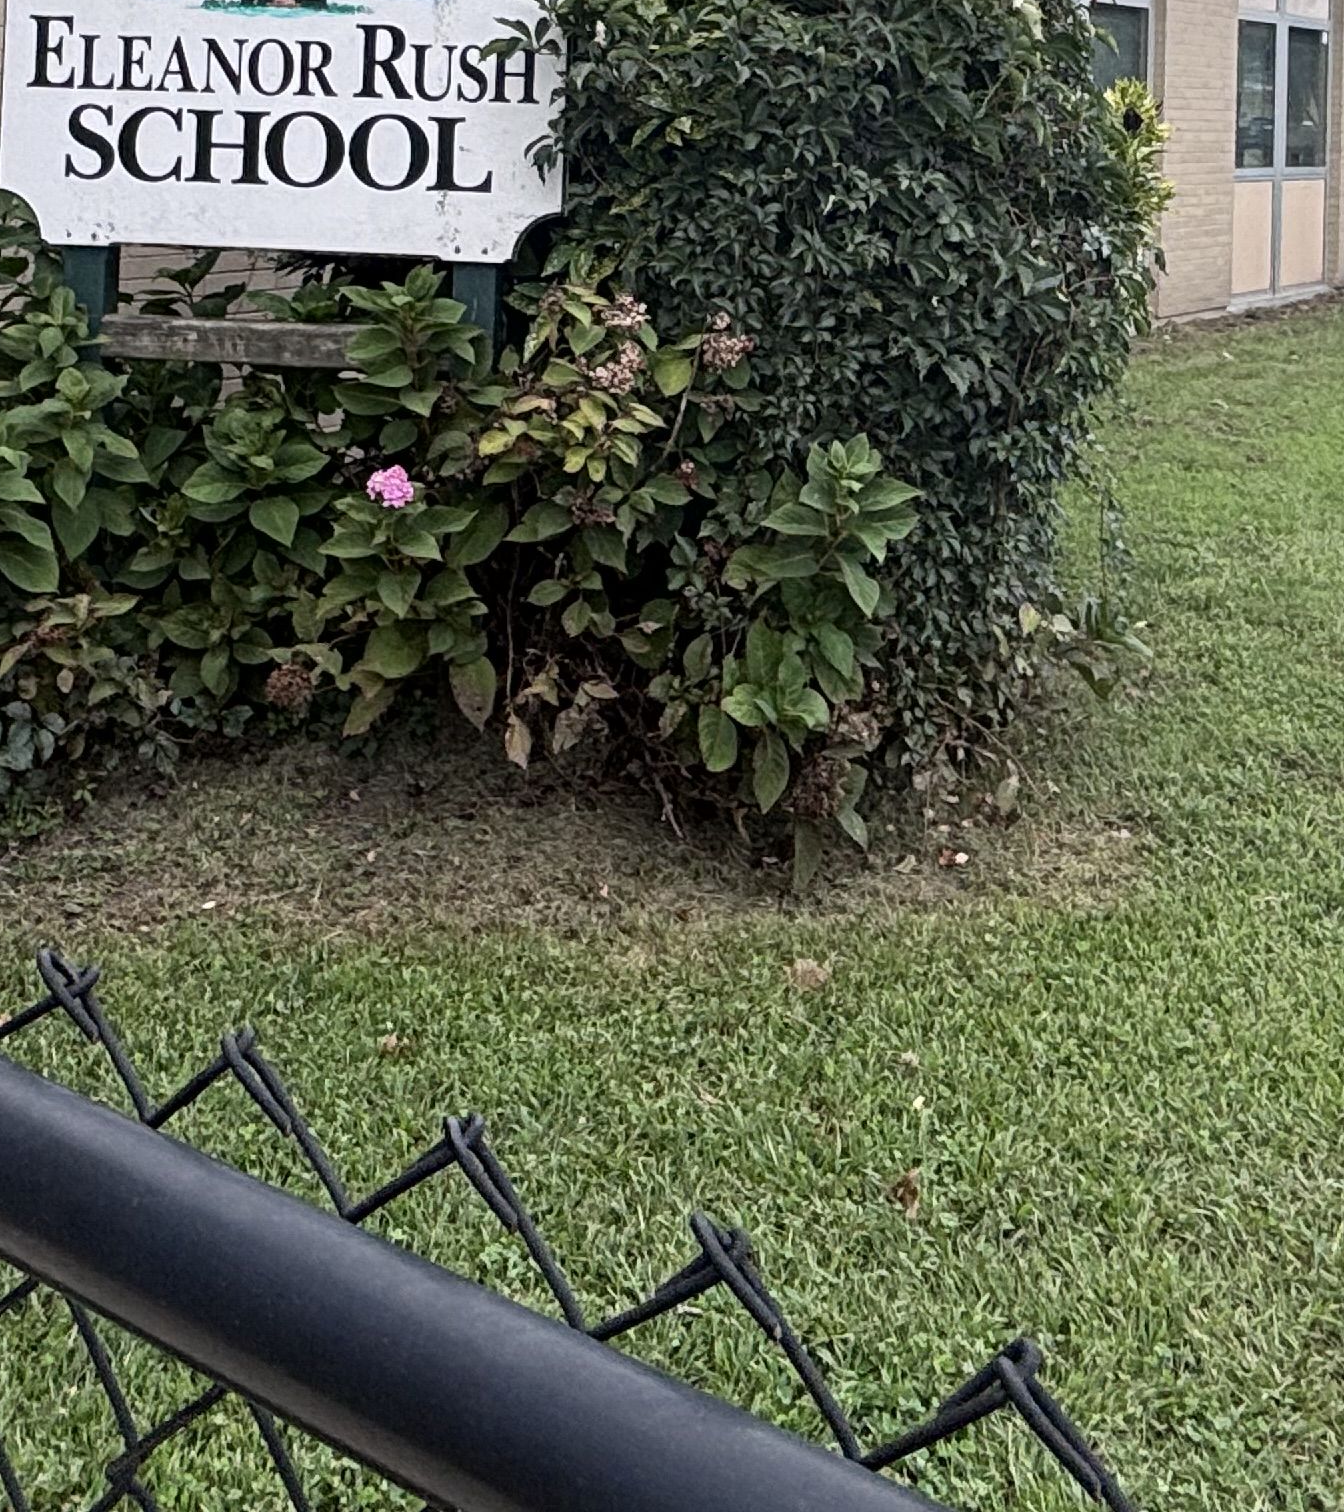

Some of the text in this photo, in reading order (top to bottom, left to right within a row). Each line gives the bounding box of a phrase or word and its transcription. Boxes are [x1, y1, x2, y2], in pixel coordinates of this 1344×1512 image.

[27, 14, 540, 104] ELEANOR RUSH
[64, 104, 493, 193] SCHOOL
